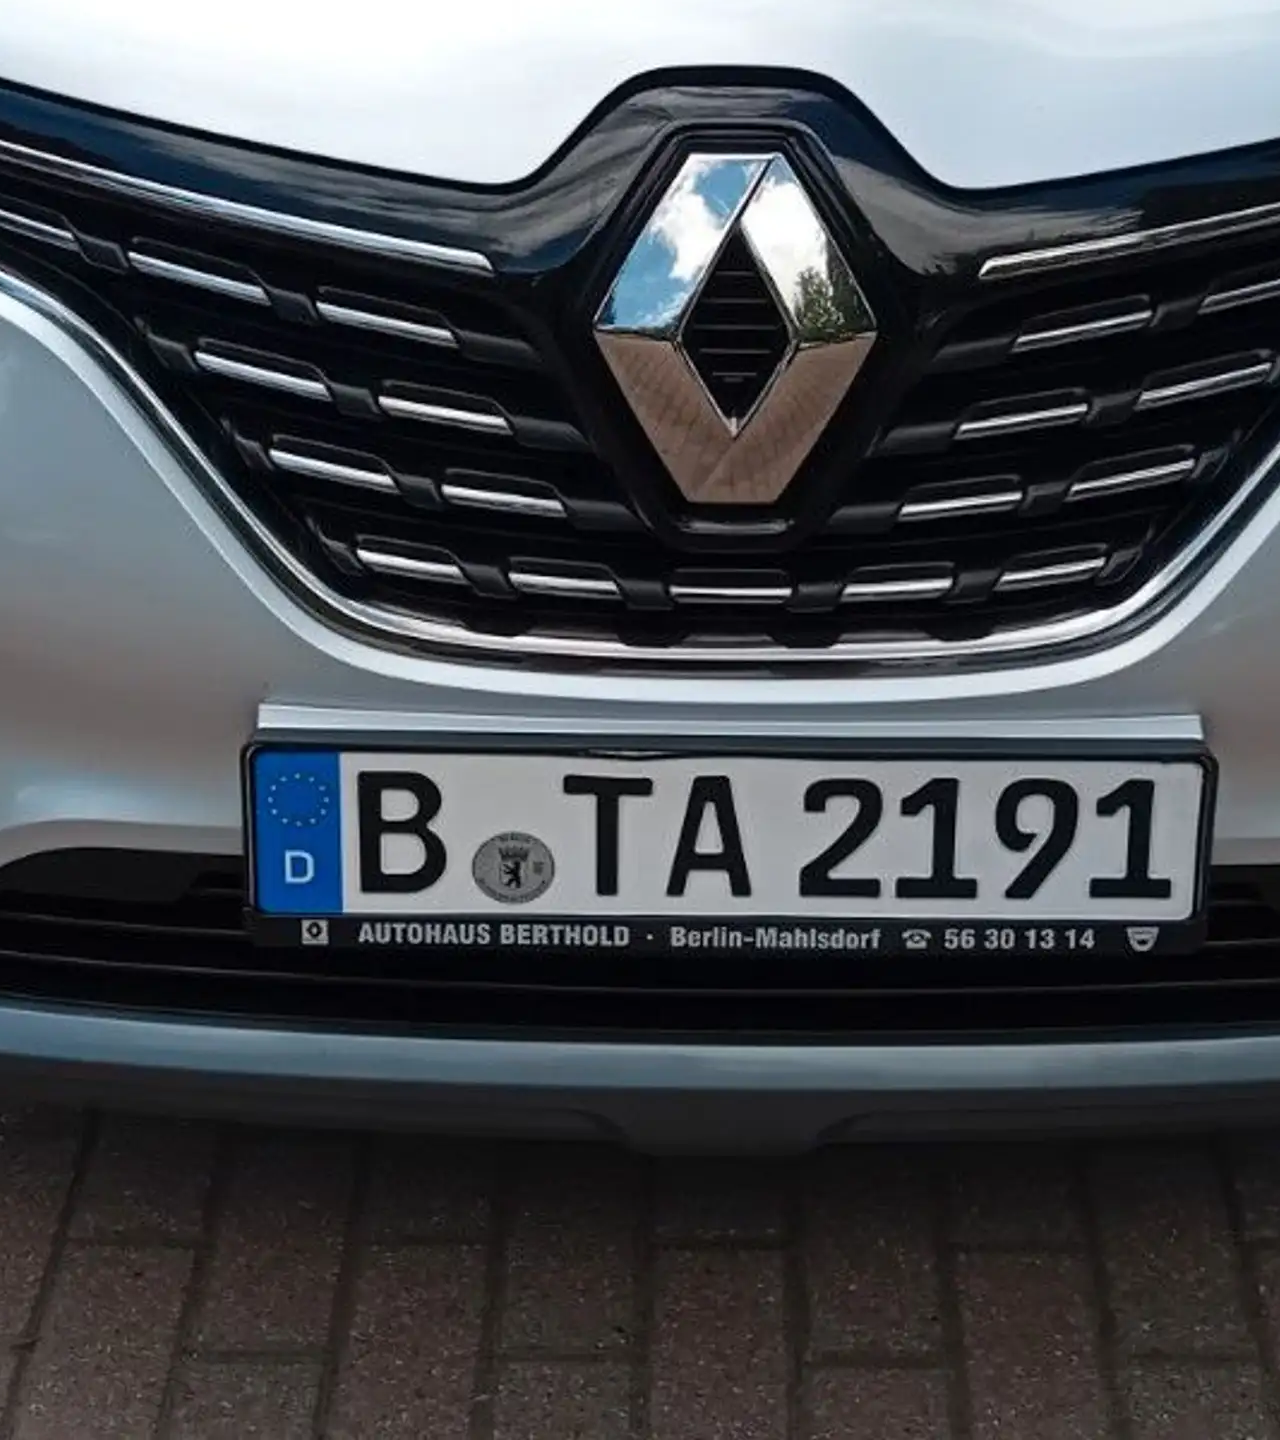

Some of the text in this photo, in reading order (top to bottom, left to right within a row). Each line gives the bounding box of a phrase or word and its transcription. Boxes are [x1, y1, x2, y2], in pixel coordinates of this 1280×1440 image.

[357, 770, 1172, 900] B TA 2191
[285, 851, 313, 882] D
[358, 922, 1095, 949] AUTOHAUS BERTHOLD Berlin-Mahlsdorf 56 30 13 14
